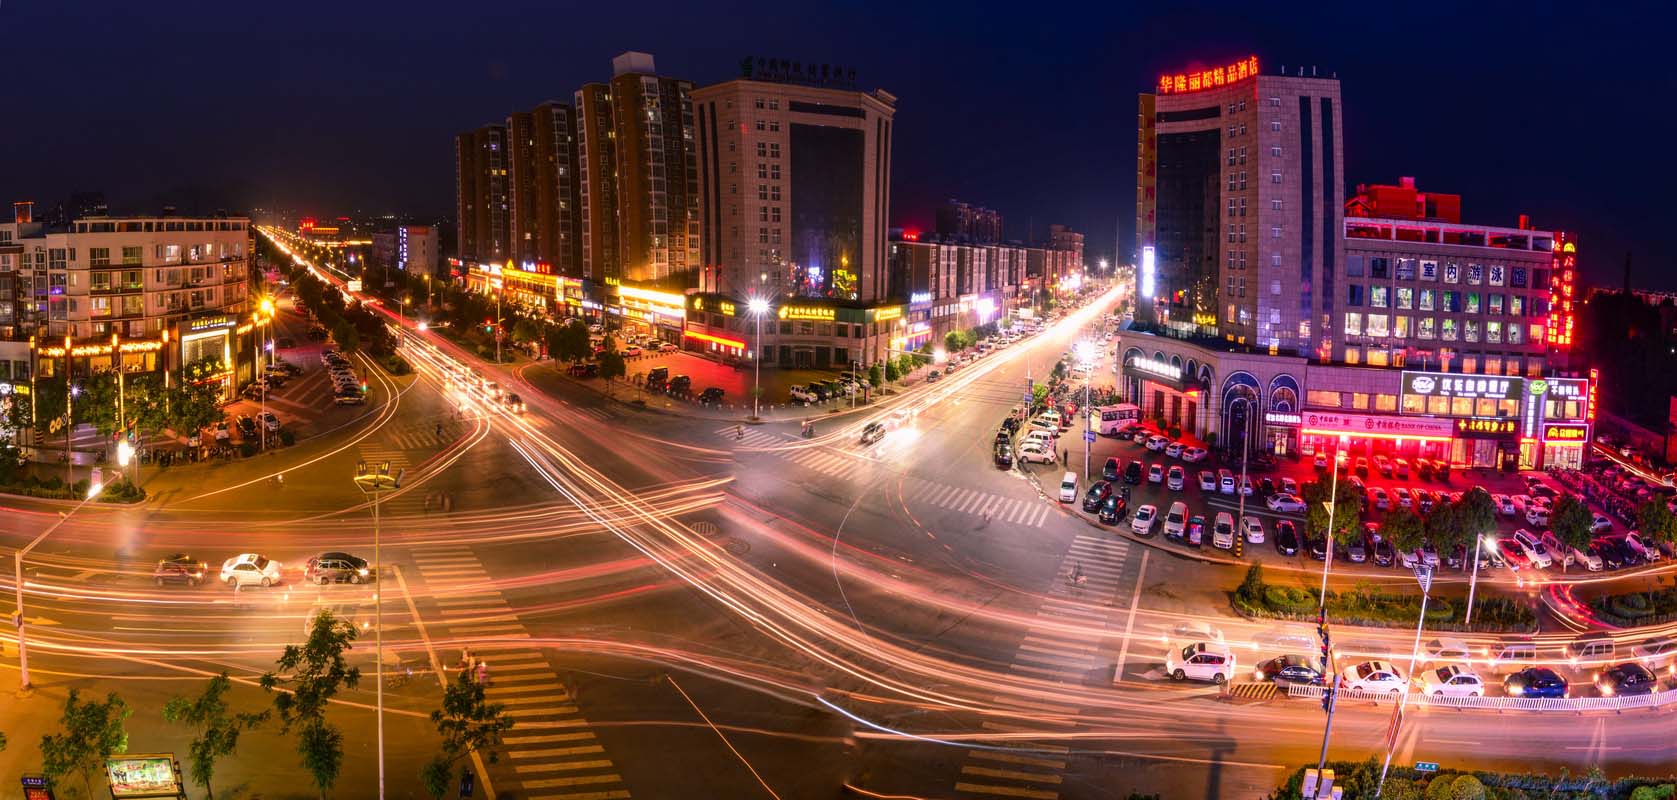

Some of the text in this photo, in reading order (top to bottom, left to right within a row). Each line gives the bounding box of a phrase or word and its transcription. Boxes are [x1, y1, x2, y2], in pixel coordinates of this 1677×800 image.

[1160, 56, 1259, 93] 华隆丽都精品酒店
[1423, 262, 1526, 286] 室内游泳馆
[1376, 421, 1400, 431] 中国银行
